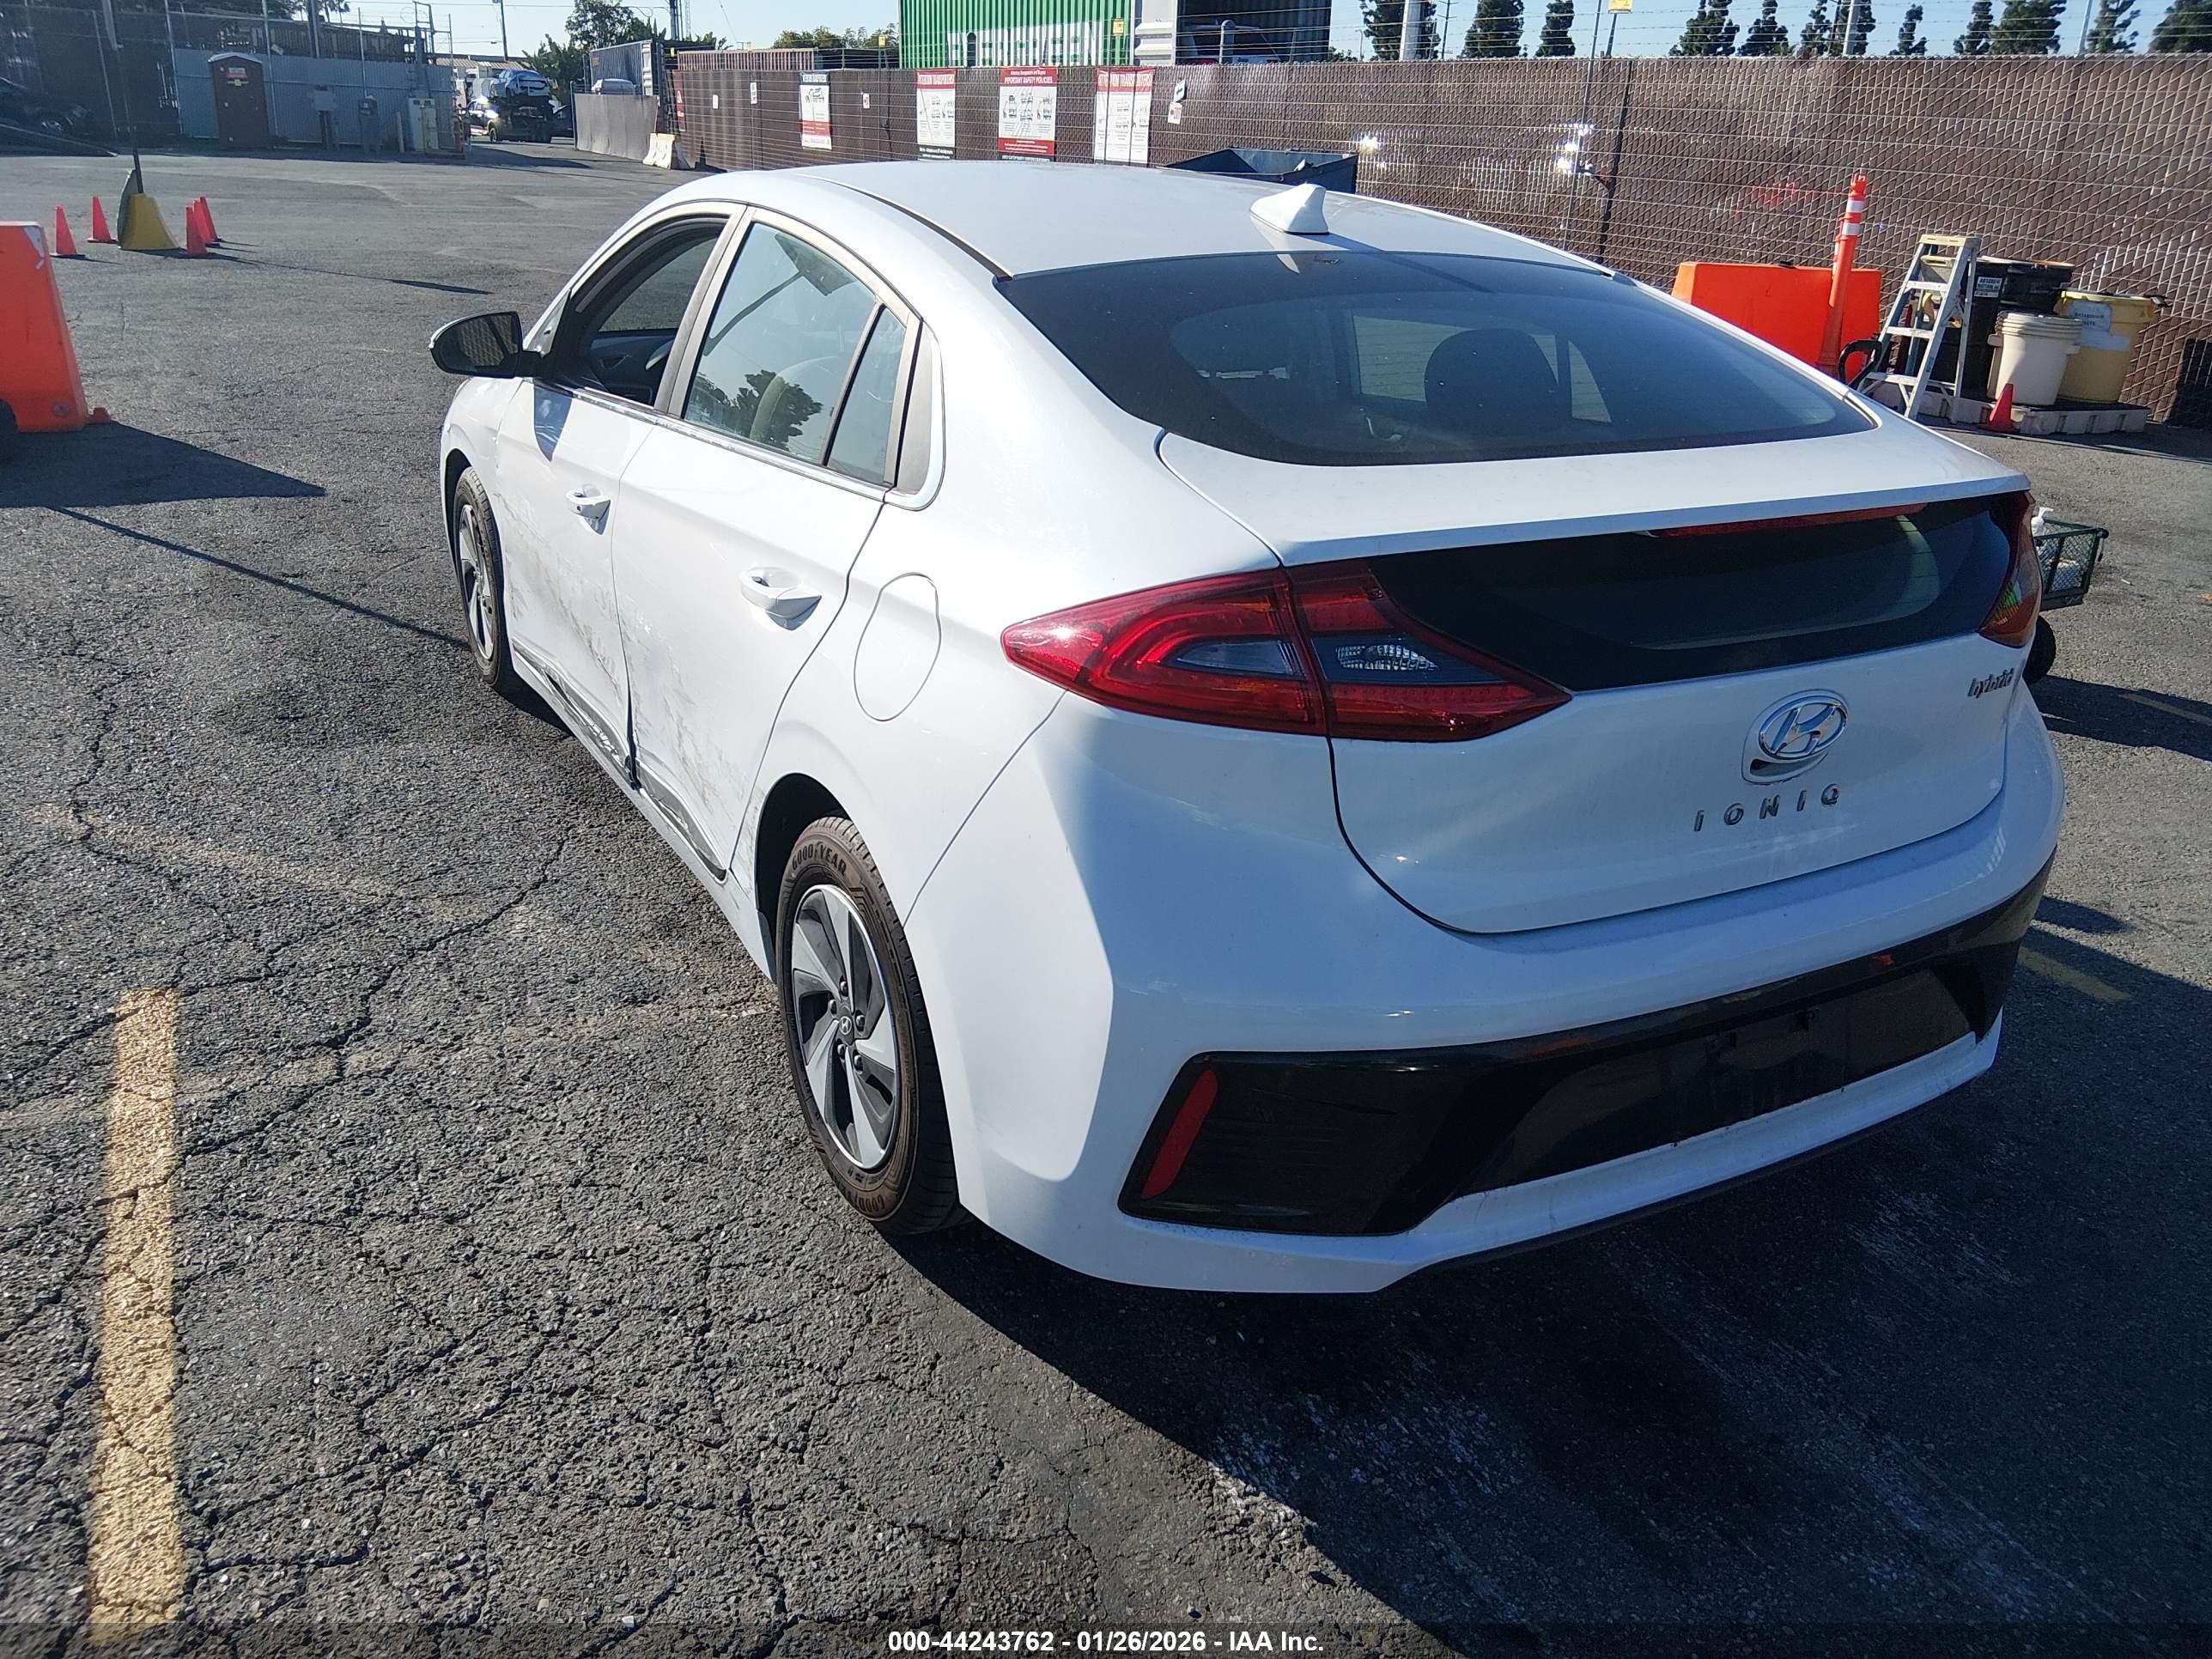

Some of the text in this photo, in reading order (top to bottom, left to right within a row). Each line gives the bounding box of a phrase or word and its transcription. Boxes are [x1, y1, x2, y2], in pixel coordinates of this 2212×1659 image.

[1967, 667, 2014, 699] hybrid
[1693, 783, 1840, 832] IONIQ
[792, 842, 847, 877] GOODYEAR
